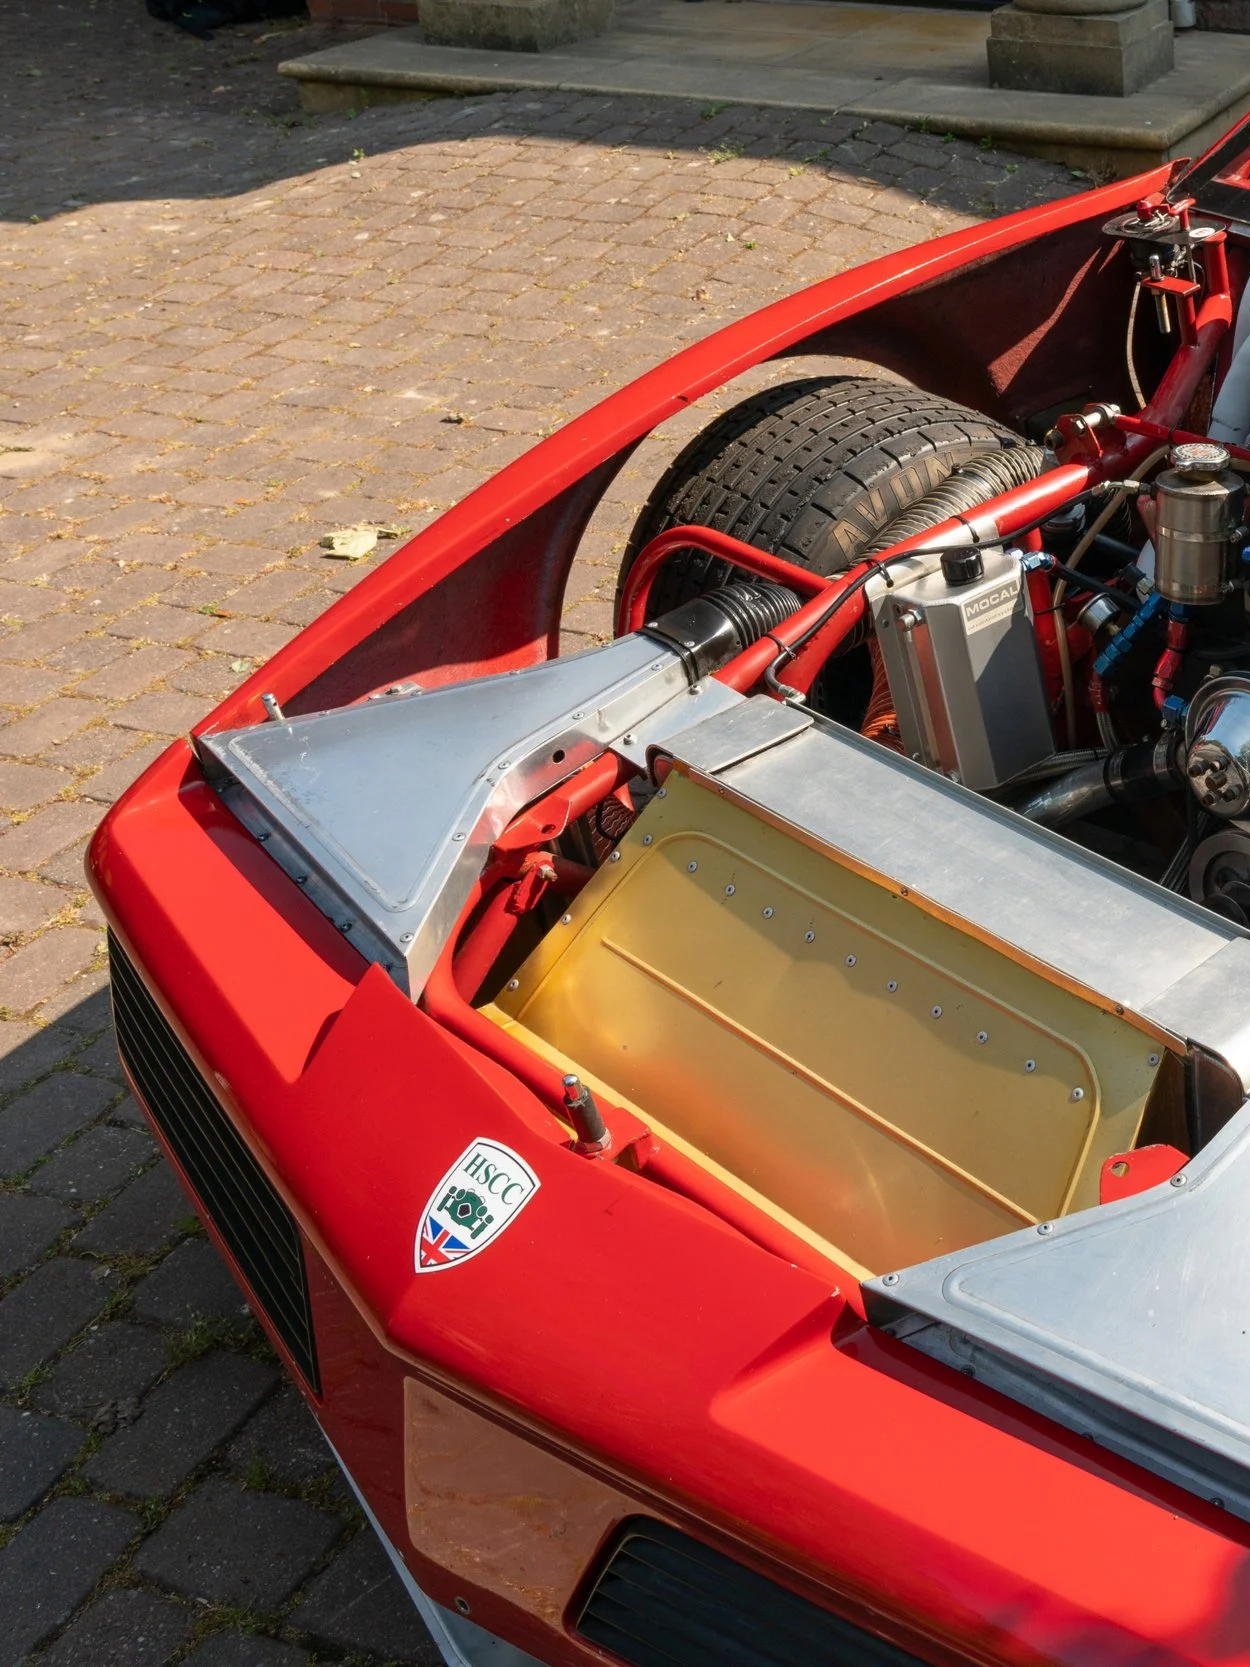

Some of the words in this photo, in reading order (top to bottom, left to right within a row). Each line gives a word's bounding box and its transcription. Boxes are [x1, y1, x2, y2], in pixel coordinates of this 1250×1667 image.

[833, 452, 954, 563] AVON
[966, 586, 1019, 617] MOCAL
[463, 1152, 525, 1206] HSCC
